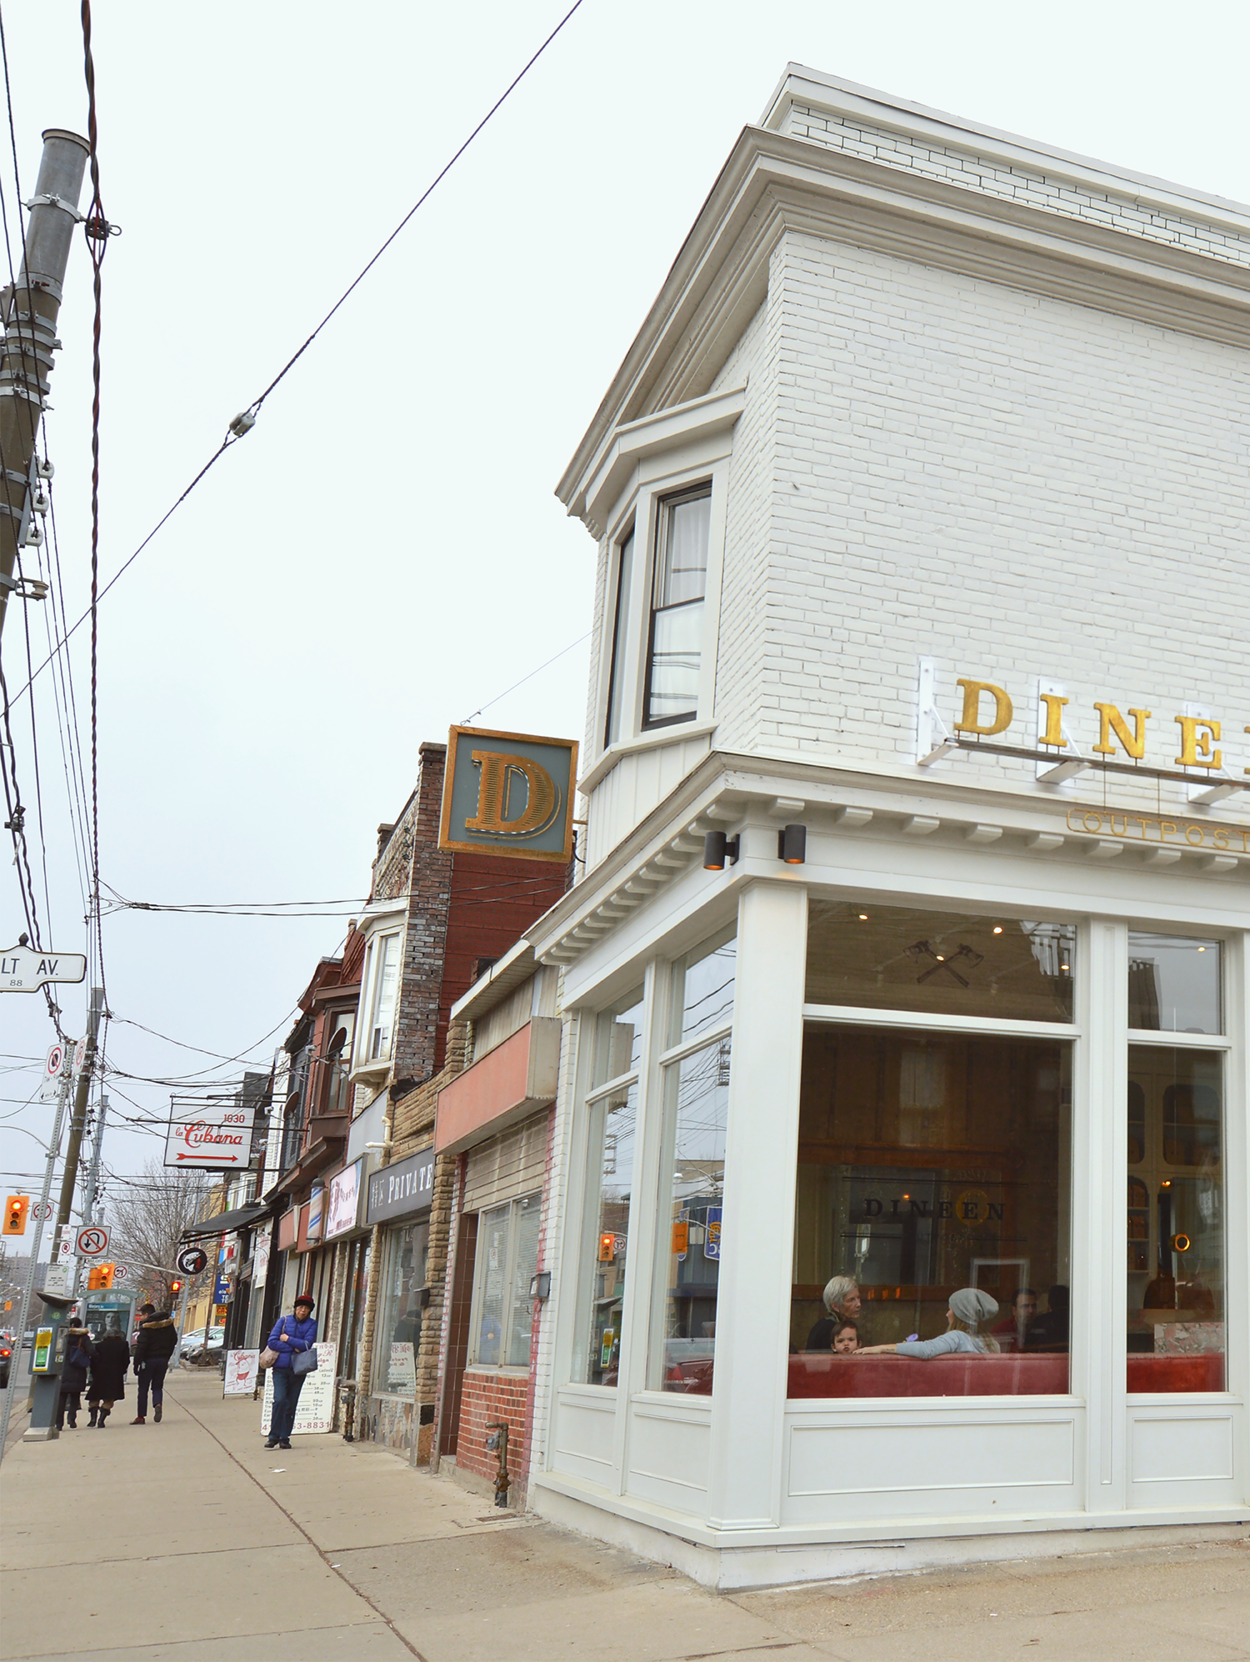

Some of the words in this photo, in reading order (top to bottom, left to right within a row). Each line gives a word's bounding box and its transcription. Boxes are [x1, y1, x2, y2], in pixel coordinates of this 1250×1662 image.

[465, 750, 561, 839] D
[36, 959, 59, 976] AV.
[9, 979, 23, 987] 88
[184, 1120, 243, 1148] Cubana
[864, 1198, 1006, 1221] DINEEN
